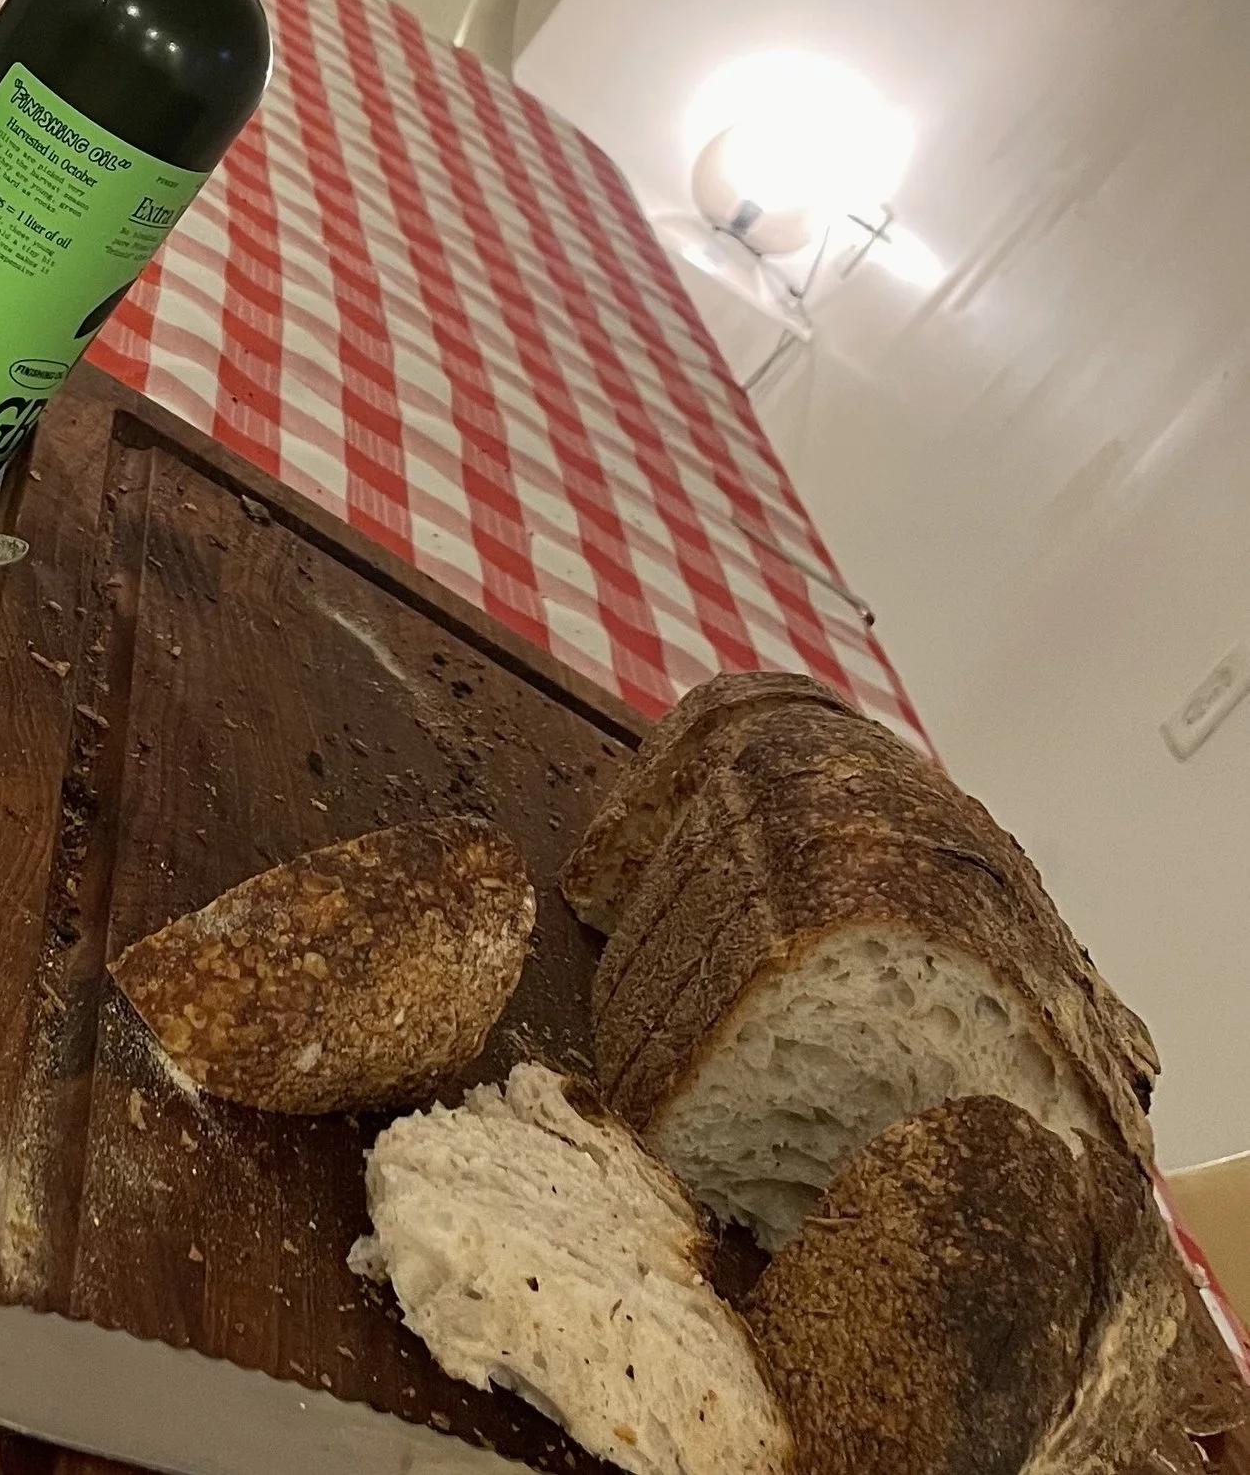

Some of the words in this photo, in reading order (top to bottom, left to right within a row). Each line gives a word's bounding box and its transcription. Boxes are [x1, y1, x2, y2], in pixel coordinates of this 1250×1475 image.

[6, 116, 51, 156] Harvested
[47, 150, 59, 165] in
[60, 159, 98, 188] October
[17, 210, 25, 221] 1
[23, 214, 46, 234] liter
[45, 231, 60, 241] of
[56, 238, 73, 249] oil
[131, 197, 175, 224] Extra
